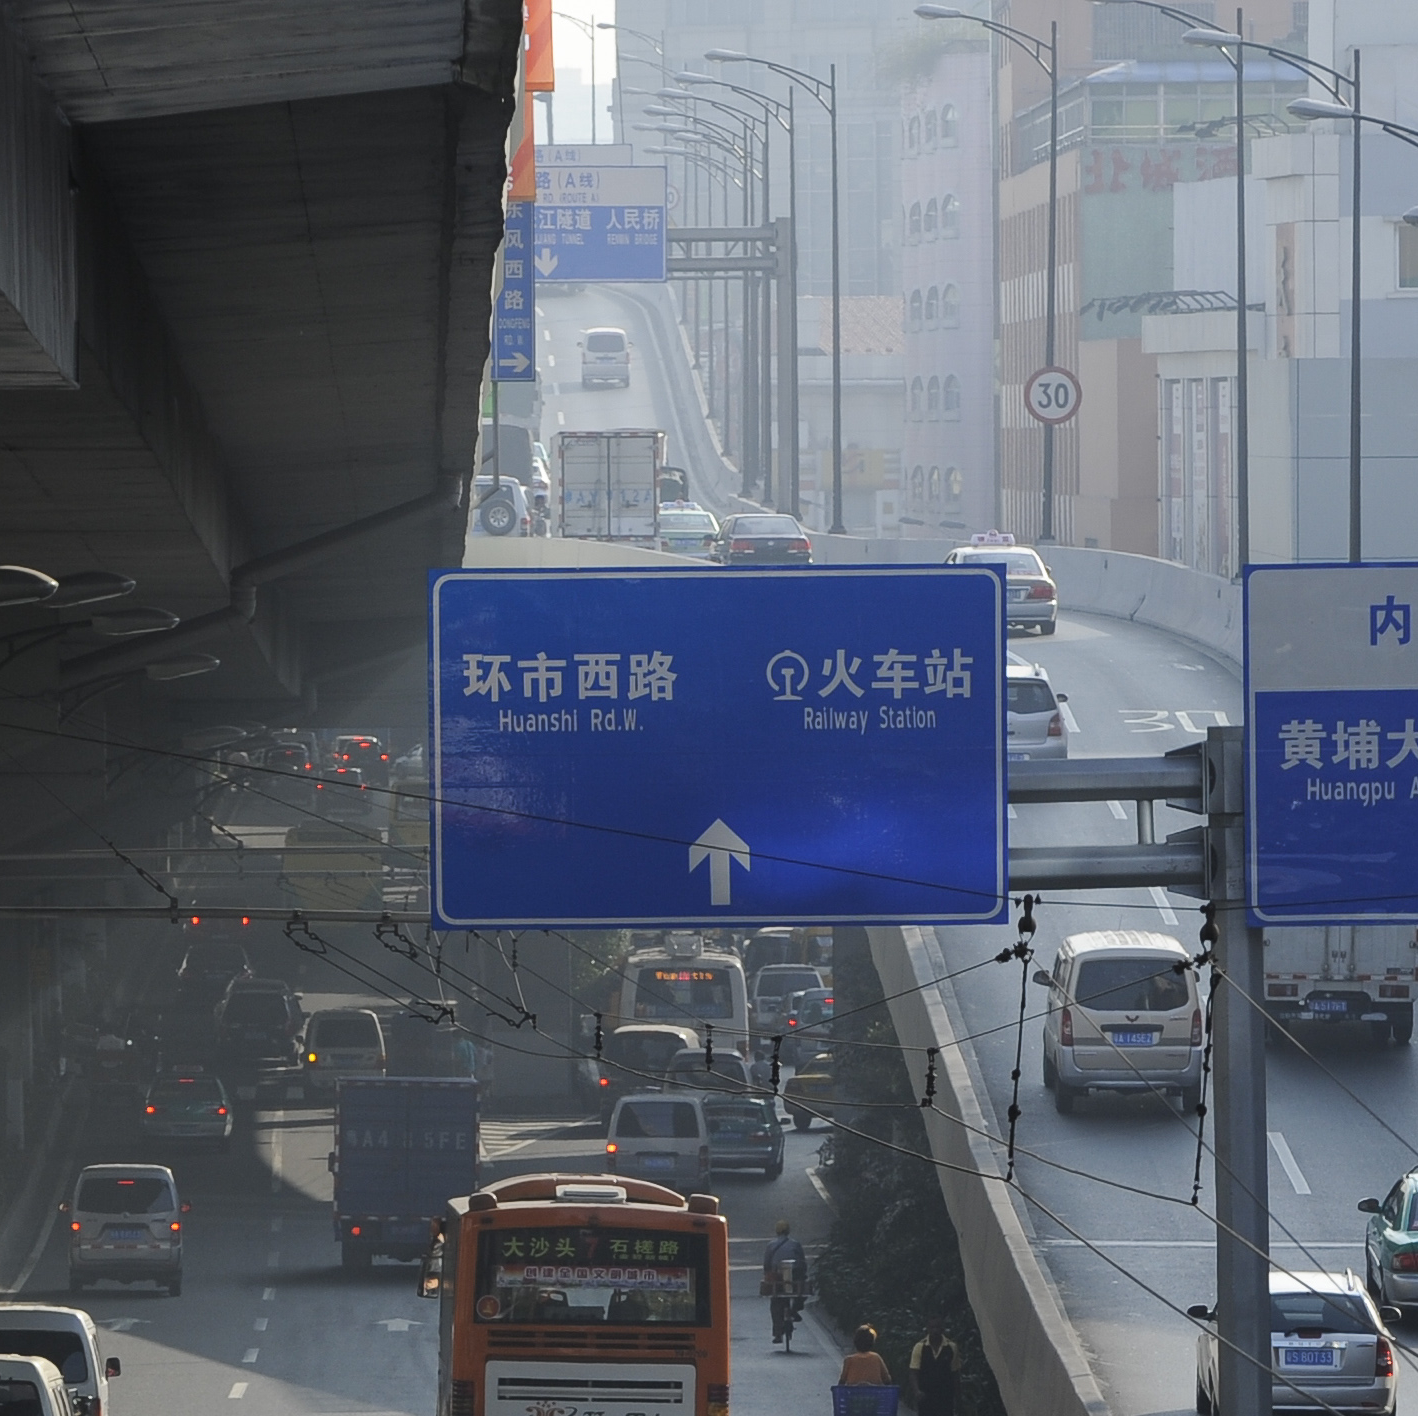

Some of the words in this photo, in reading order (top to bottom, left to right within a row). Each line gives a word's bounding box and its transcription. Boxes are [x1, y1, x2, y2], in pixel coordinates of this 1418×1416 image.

[606, 208, 660, 230] 人民桥
[1036, 383, 1069, 409] 30
[462, 651, 678, 703] 环市西路
[818, 648, 974, 699] 火车站
[498, 708, 578, 733] Huanshi
[803, 706, 868, 734] Railway
[879, 705, 937, 730] Station
[1306, 777, 1395, 804] Huangpu
[503, 1236, 576, 1258] 大沙头
[584, 1237, 598, 1259] 7
[524, 1267, 658, 1281] 创建全国文明城市
[1302, 1352, 1332, 1364] 80T33
